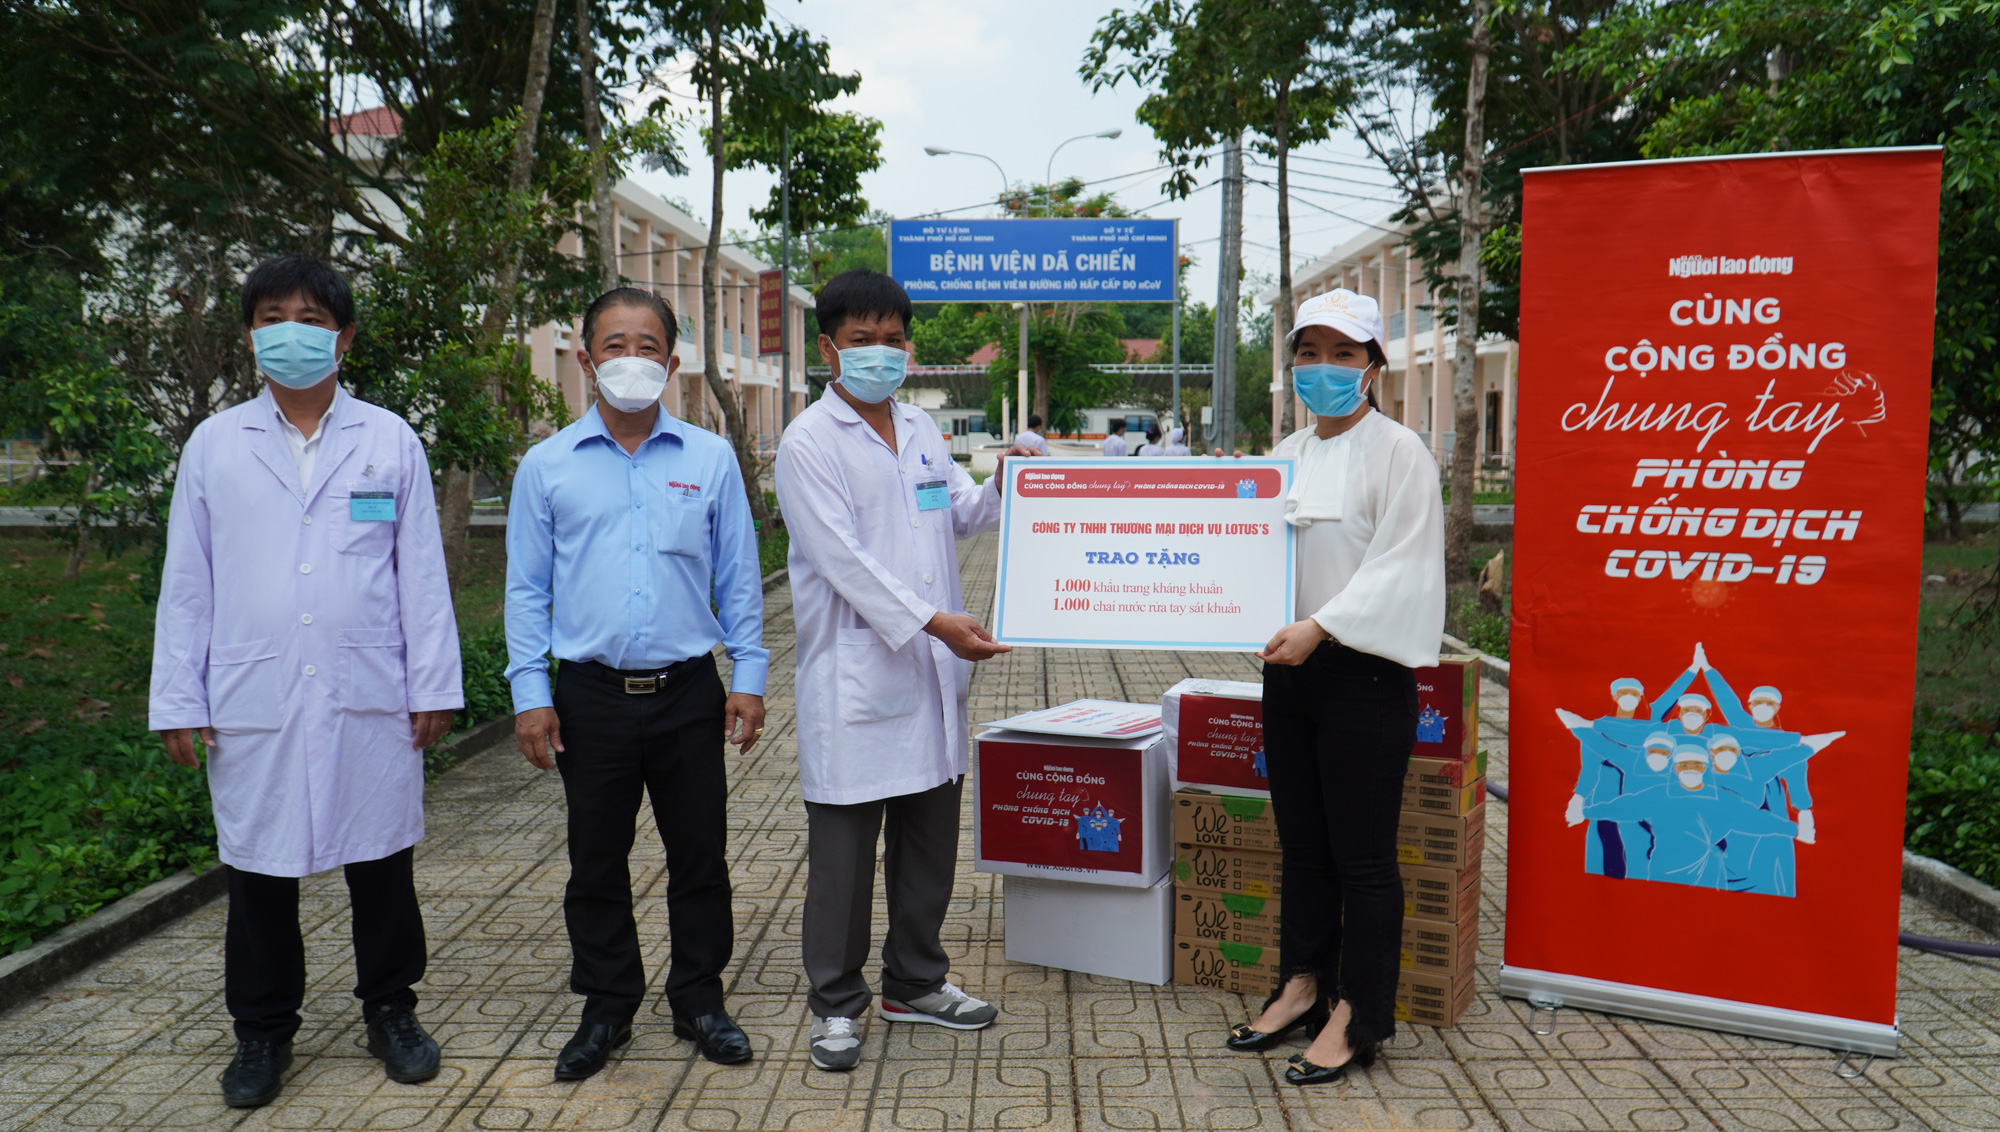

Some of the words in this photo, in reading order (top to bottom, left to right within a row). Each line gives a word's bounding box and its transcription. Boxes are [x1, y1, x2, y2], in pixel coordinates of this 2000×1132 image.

[930, 250, 984, 274] BỆNH
[990, 250, 1035, 274] VIỆN
[1043, 250, 1069, 271] DÃ
[1076, 248, 1135, 271] CHIẾN
[1720, 256, 1746, 274] lao
[904, 278, 938, 291] PHÒNG,
[941, 277, 973, 290] CHỐNG
[975, 278, 1000, 291] BỆNH
[1004, 279, 1026, 290] VIÊM
[1030, 278, 1061, 290] ĐƯỜNG
[1064, 278, 1077, 289] HÔ
[1080, 277, 1099, 289] HẤP
[1102, 277, 1120, 289] CẤP
[1123, 280, 1136, 289] DO
[1139, 280, 1161, 290] nCoV
[1670, 293, 1780, 326] CÙNG
[1605, 339, 1715, 377] CỘNG
[1727, 332, 1846, 370] ĐỒNG
[1562, 375, 1730, 453] chung
[1746, 378, 1844, 454] tay
[1632, 451, 1806, 490] PHÒNG
[1045, 482, 1065, 490] CỘNG
[1089, 480, 1111, 491] chung
[1113, 481, 1126, 491] tay
[1032, 521, 1060, 534] CÔNG
[1064, 523, 1076, 533] TY
[1080, 523, 1106, 534] TNHH
[1110, 522, 1152, 534] THƯƠNG
[1156, 523, 1175, 536] MẠI
[1179, 524, 1204, 536] DỊCH
[1208, 524, 1222, 537] VỤ
[1226, 523, 1269, 535] LOTUS'S
[1576, 494, 1740, 537] CHỐNG
[1741, 508, 1863, 547] DỊCH
[1086, 552, 1139, 564] TRAO
[1145, 548, 1200, 568] TẶNG
[1604, 550, 1827, 585] COVID-19
[1055, 579, 1091, 592] 1.000
[1094, 579, 1119, 592] khẩu
[1123, 584, 1150, 596] trang
[1153, 582, 1186, 596] kháng
[1190, 580, 1223, 594] khuẩn
[1054, 598, 1090, 611] 1.000
[1093, 601, 1115, 611] chai
[1119, 601, 1145, 612] nước
[1149, 602, 1166, 612] rửa
[1170, 604, 1186, 616] tay
[1189, 602, 1204, 613] sát
[1208, 600, 1241, 613] khuẩn
[1208, 717, 1229, 726] CÙNG
[1231, 719, 1253, 728] CỘNG
[1207, 728, 1238, 744] chung
[1241, 731, 1257, 746] tay
[1210, 750, 1248, 759] COVID-19
[1016, 770, 1043, 780] CÙNG
[1046, 772, 1073, 783] CỘNG
[1016, 784, 1055, 806] chung
[1059, 788, 1080, 808] tay
[992, 803, 1019, 811] PHÒNG
[1022, 805, 1049, 814] CHỐNG
[1022, 816, 1069, 826] COVID-19
[1192, 806, 1229, 834] We
[1196, 833, 1227, 844] LOVE
[1192, 849, 1229, 878] We
[1197, 876, 1226, 888] LOVE
[1193, 901, 1229, 929] We
[1197, 928, 1226, 940] LOVE
[1190, 949, 1226, 978] We
[1195, 976, 1224, 988] LOVE
